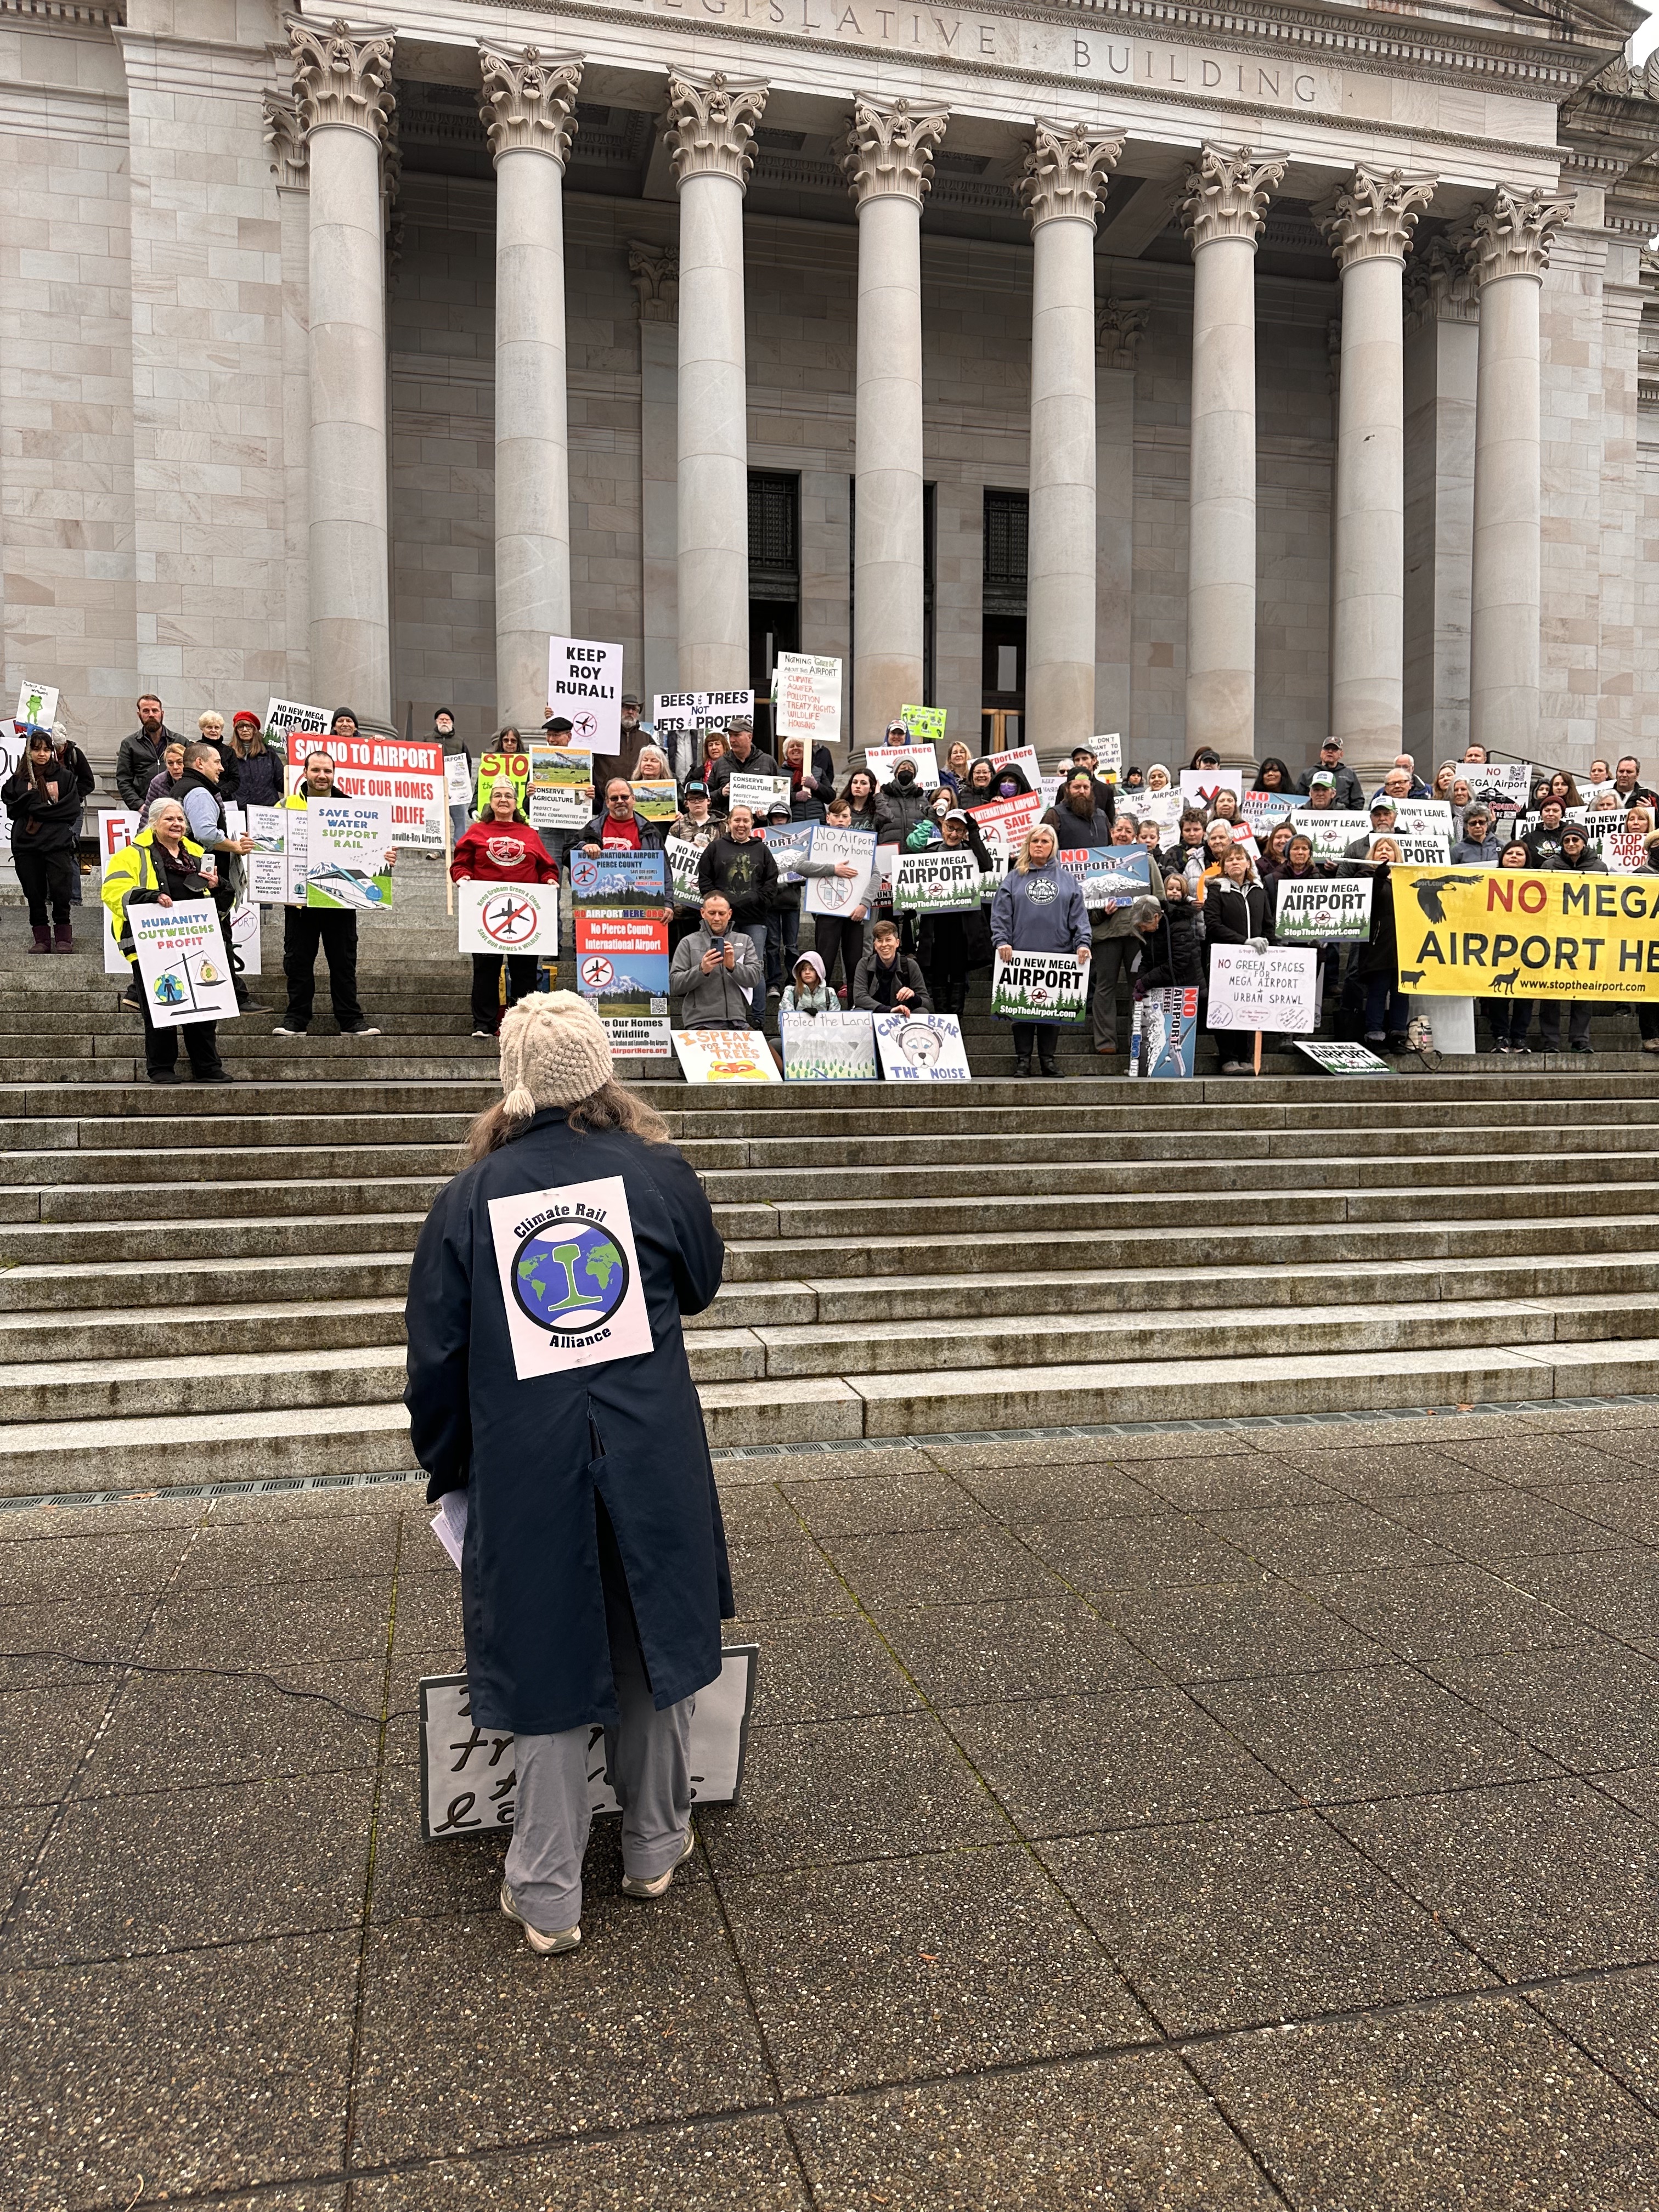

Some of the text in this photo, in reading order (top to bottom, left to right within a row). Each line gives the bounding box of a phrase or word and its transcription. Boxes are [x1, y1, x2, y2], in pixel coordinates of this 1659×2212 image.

[631, 0, 1317, 102] GISLATIVE BUILDING
[567, 646, 606, 662] KEEP
[570, 664, 601, 680] ROY
[810, 666, 838, 677] AIRPORT
[788, 675, 813, 684] CLIMATE
[556, 680, 614, 699] RURAL!
[787, 683, 814, 693] AQUIFER
[661, 691, 748, 707] BEES TREES
[787, 691, 820, 704] POLLUTION
[289, 707, 303, 716] NEW
[306, 710, 324, 720] MEGA
[691, 706, 709, 715] NOT
[786, 701, 835, 714] TREATY RIGHTS
[787, 711, 821, 721] WILDLIFE
[654, 718, 684, 731] JETS
[788, 719, 816, 730] HOUSING
[327, 742, 437, 769] NO TO AIRPORT
[881, 748, 910, 756] Airport
[1014, 749, 1032, 759] Here
[337, 776, 433, 800] SAVE OUR HOMES
[1494, 779, 1527, 789] Airport
[1152, 788, 1183, 799] AIRPORT
[1245, 791, 1269, 801] NO
[975, 795, 1037, 820] INTERNATIONAL AIRPORT
[1244, 802, 1291, 811] AIRPORT
[1400, 808, 1421, 816] WON'T
[319, 809, 379, 819] SAVE OUR
[327, 820, 368, 828] WATER
[1004, 814, 1032, 830] SAVE
[322, 830, 379, 839] SUPPORT
[422, 834, 442, 844] Airports
[817, 827, 876, 845] No Airport
[1610, 834, 1640, 845] STOP
[334, 839, 363, 848] RAIL
[676, 845, 688, 855] NO
[813, 842, 873, 856] on my home
[918, 858, 938, 867] NEW
[941, 856, 967, 865] MEGA
[1061, 849, 1088, 862] NO
[1062, 861, 1117, 872] AIRPORT
[898, 865, 973, 884] AIRPORT
[477, 893, 489, 906] Keep
[488, 885, 508, 895] Graham
[509, 885, 525, 895] Green
[529, 895, 541, 910] Clean
[1283, 894, 1366, 910] AIRPORT
[1487, 878, 1547, 913] NO
[901, 898, 972, 909] StopTheAirport.com
[142, 914, 208, 928] HUMANITY
[138, 924, 214, 939] OUTWEIGHS
[590, 923, 653, 935] No Pierce County
[1284, 928, 1360, 936] StopTheAirport.com
[157, 937, 203, 949] PROFIT
[477, 928, 487, 941] SAVE
[487, 940, 498, 949] OUR
[522, 932, 542, 949] WILDLIFE
[585, 938, 661, 951] International Airport
[1416, 930, 1605, 970] AIRPORT
[1007, 957, 1077, 970] NO NEW MEGA
[1218, 959, 1305, 972] NO GREEN SPACES
[999, 968, 1083, 989] AIRPORT
[1229, 977, 1298, 989] MEGA AIRPORT
[1520, 979, 1646, 992] www.stoptheairport.com
[1183, 989, 1197, 1017] NO
[1234, 992, 1303, 1005] URBAN SPRAWL
[1000, 1005, 1076, 1018] StopTheAirport.com
[1171, 988, 1182, 1045] AIRPORT
[782, 1013, 870, 1027] Protect the Land
[878, 1014, 959, 1038] CAN'T BEAR
[677, 1032, 697, 1046] I
[696, 1031, 755, 1042] SPEAK
[700, 1042, 720, 1051] FOR
[710, 1049, 760, 1060] TREES
[890, 1066, 966, 1079] THE NOISE
[514, 1203, 607, 1239] Climate Rail
[549, 1327, 612, 1348] Alliance
